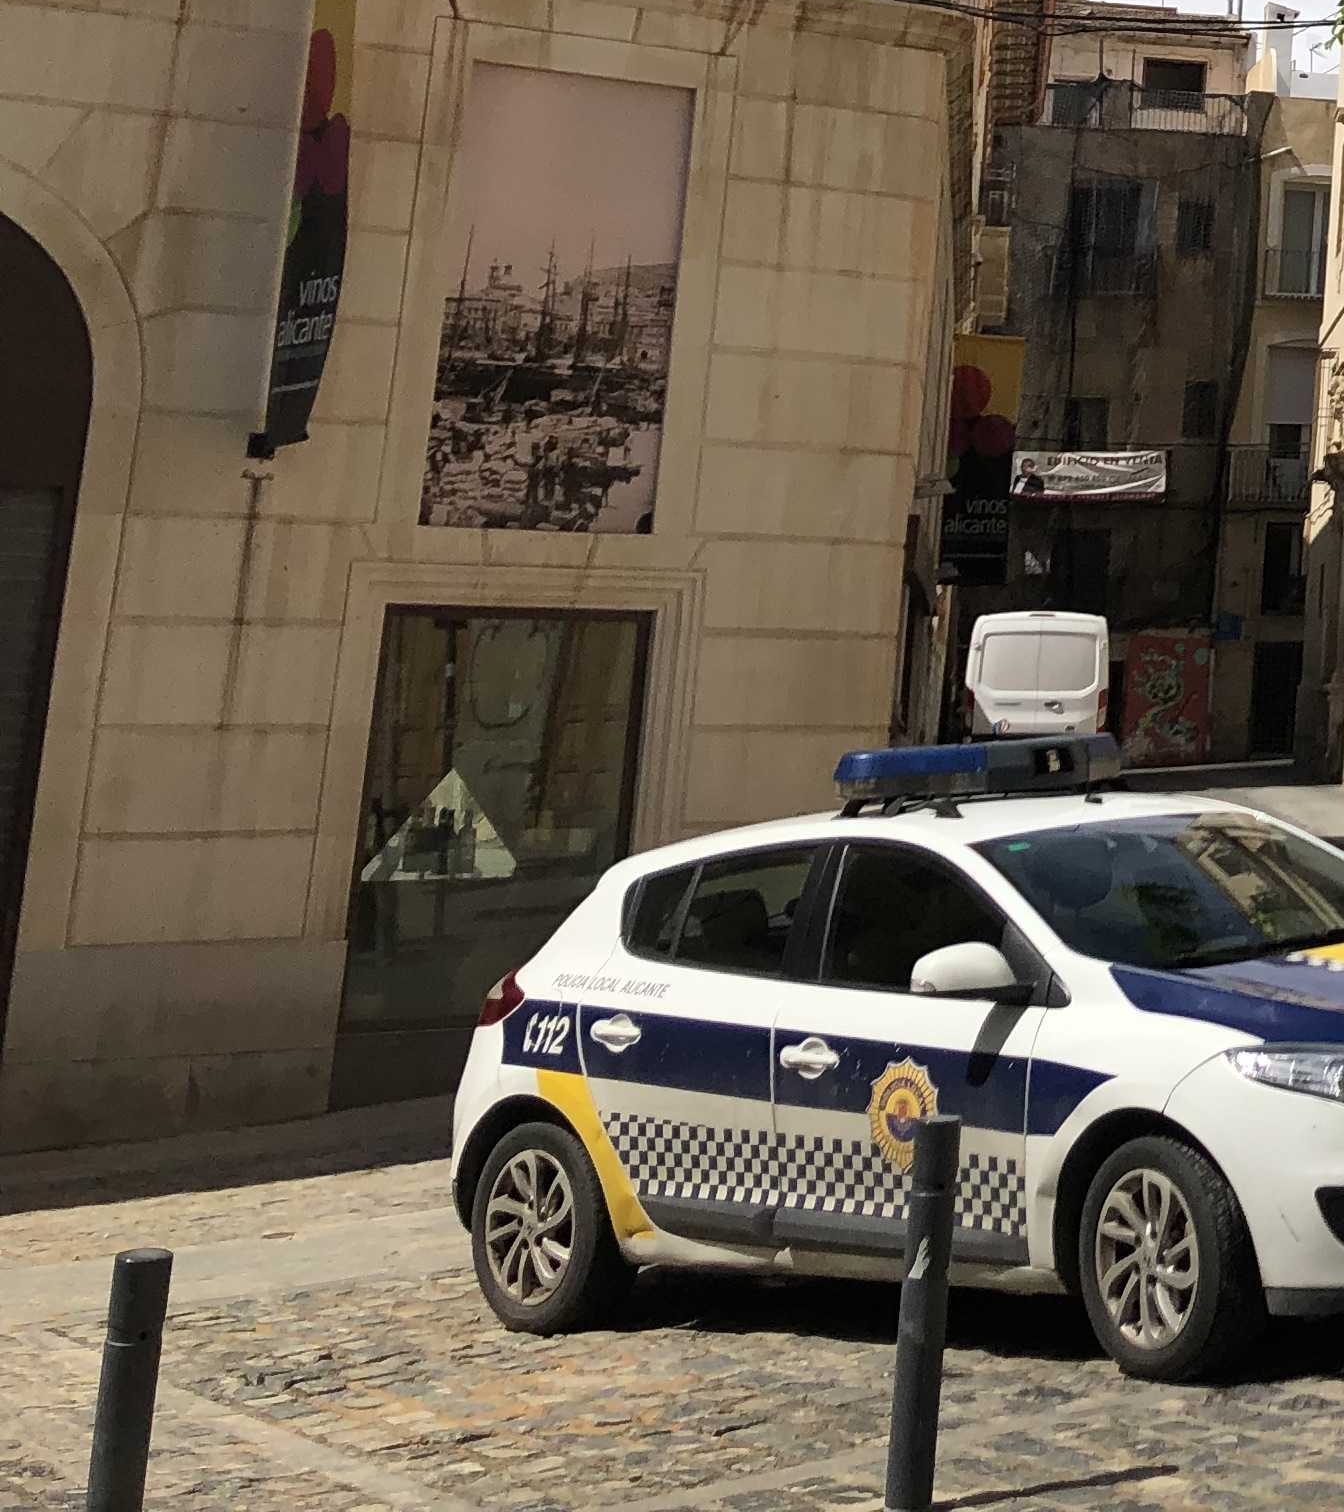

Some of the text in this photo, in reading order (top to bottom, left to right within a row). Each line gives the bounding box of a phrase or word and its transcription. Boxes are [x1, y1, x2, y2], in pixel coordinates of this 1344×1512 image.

[300, 271, 340, 306] vinos
[278, 310, 333, 347] alicante
[966, 498, 1008, 514] vinos
[944, 515, 1008, 535] alicante
[588, 974, 620, 993] LOCAL
[619, 978, 672, 999] ALICANTE
[532, 1015, 570, 1054] 112
